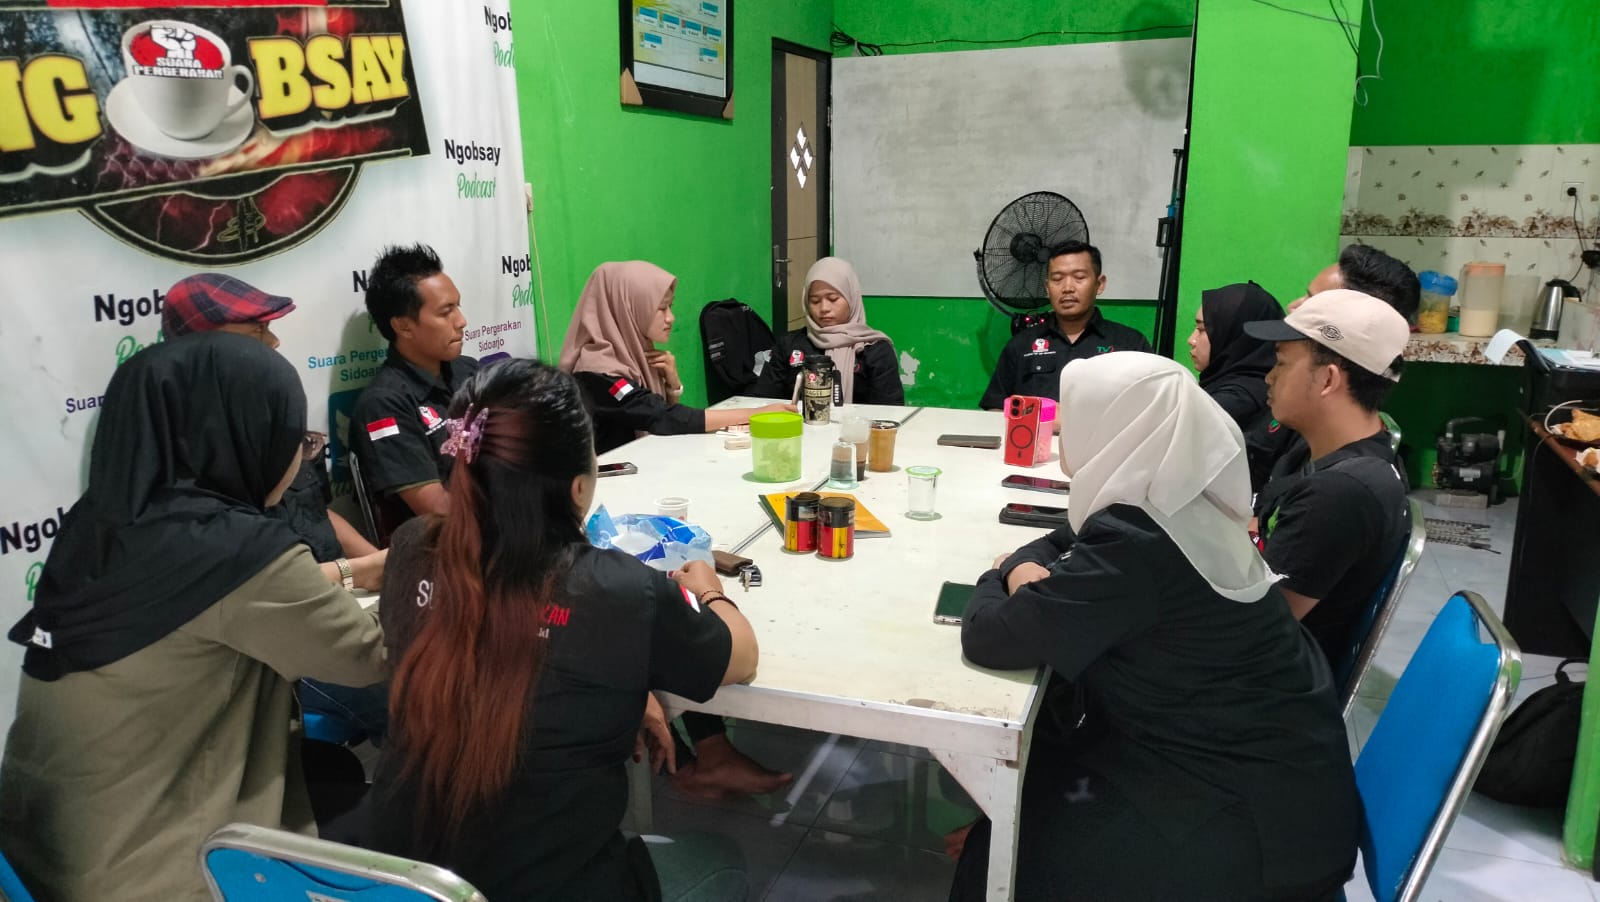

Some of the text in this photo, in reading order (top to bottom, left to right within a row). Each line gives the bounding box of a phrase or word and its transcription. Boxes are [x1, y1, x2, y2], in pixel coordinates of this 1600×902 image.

[249, 35, 409, 120] BSAY
[444, 138, 501, 166] Ngobsay
[457, 171, 496, 199] Podcast
[465, 320, 522, 341] Suara Pergerakan
[479, 337, 505, 352] Sidoarjo
[308, 354, 346, 369] Suara
